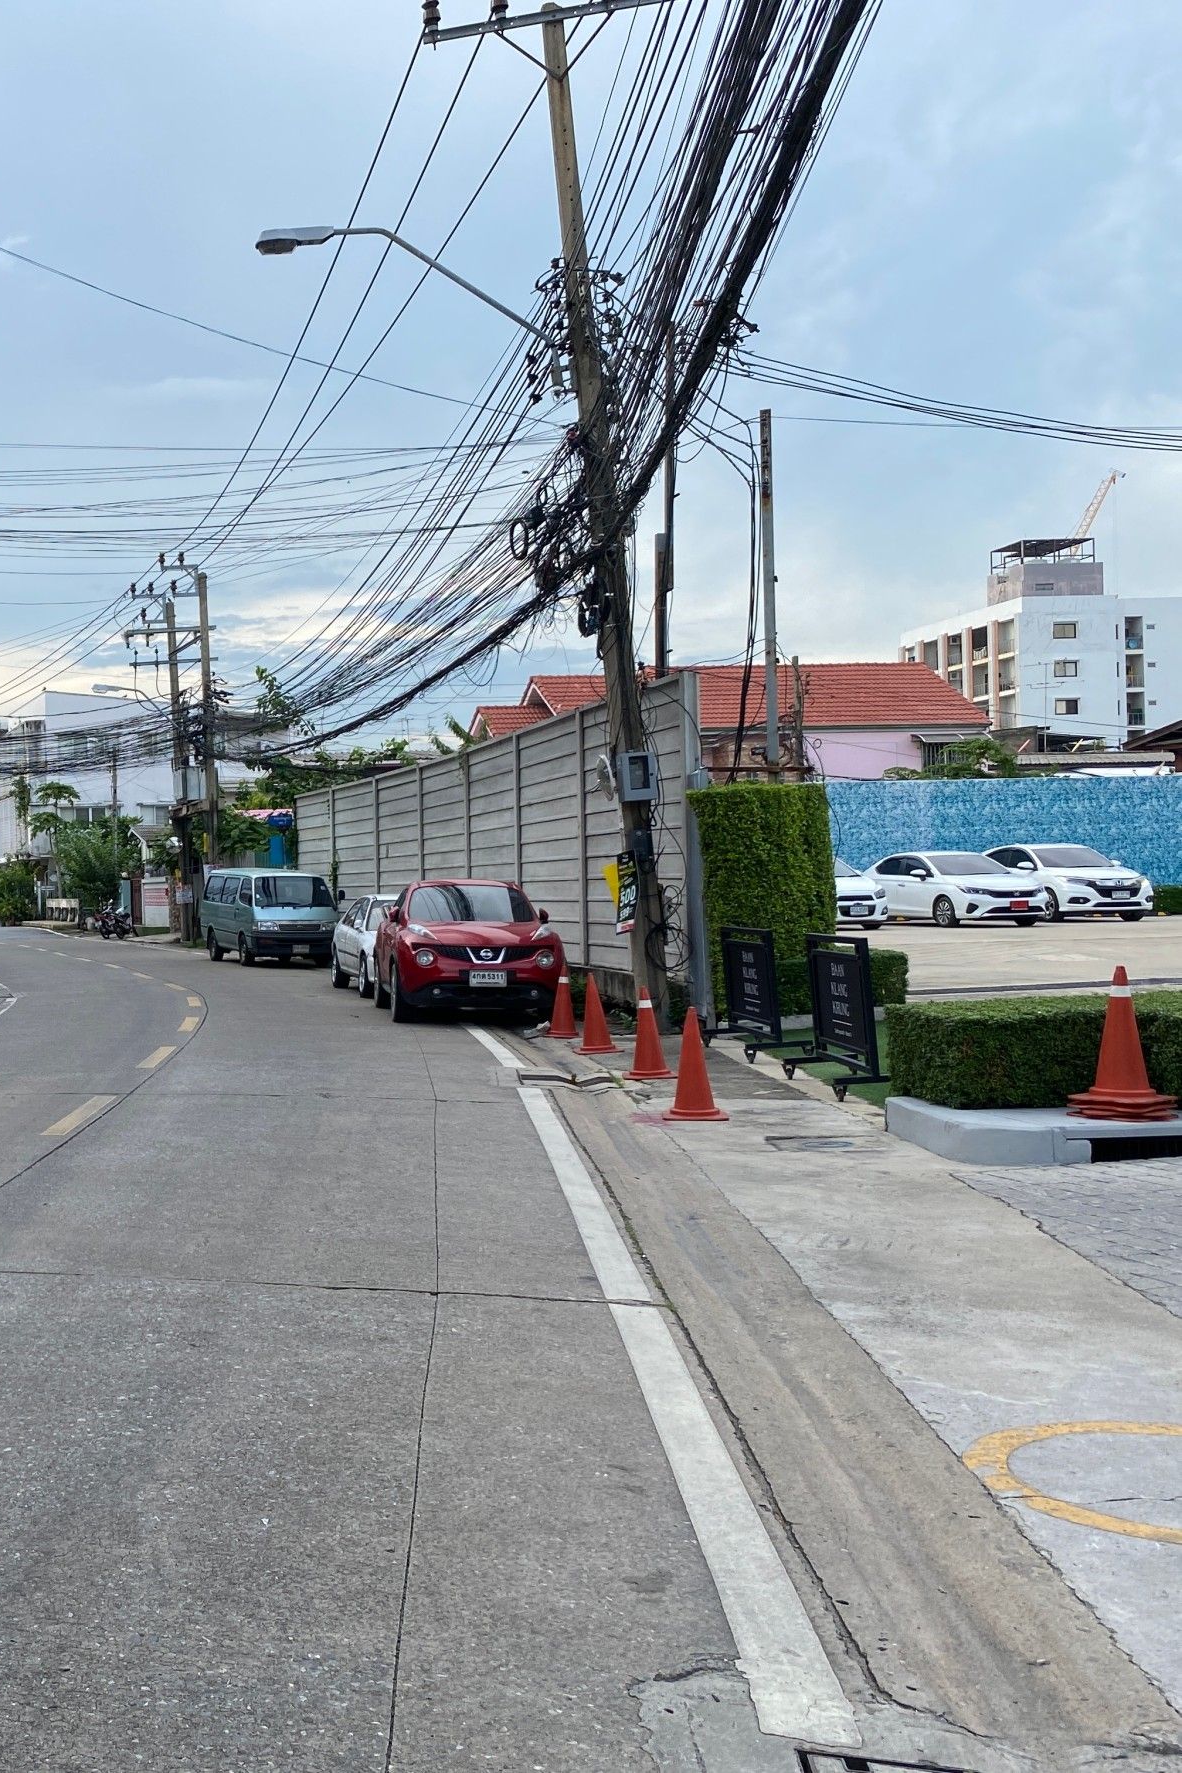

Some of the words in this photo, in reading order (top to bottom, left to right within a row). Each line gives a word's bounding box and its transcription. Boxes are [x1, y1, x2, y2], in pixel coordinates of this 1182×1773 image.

[741, 950, 754, 964] BAAN
[830, 962, 845, 977] BAAN
[830, 981, 848, 998] KLANG
[832, 1001, 850, 1017] KRUNG
